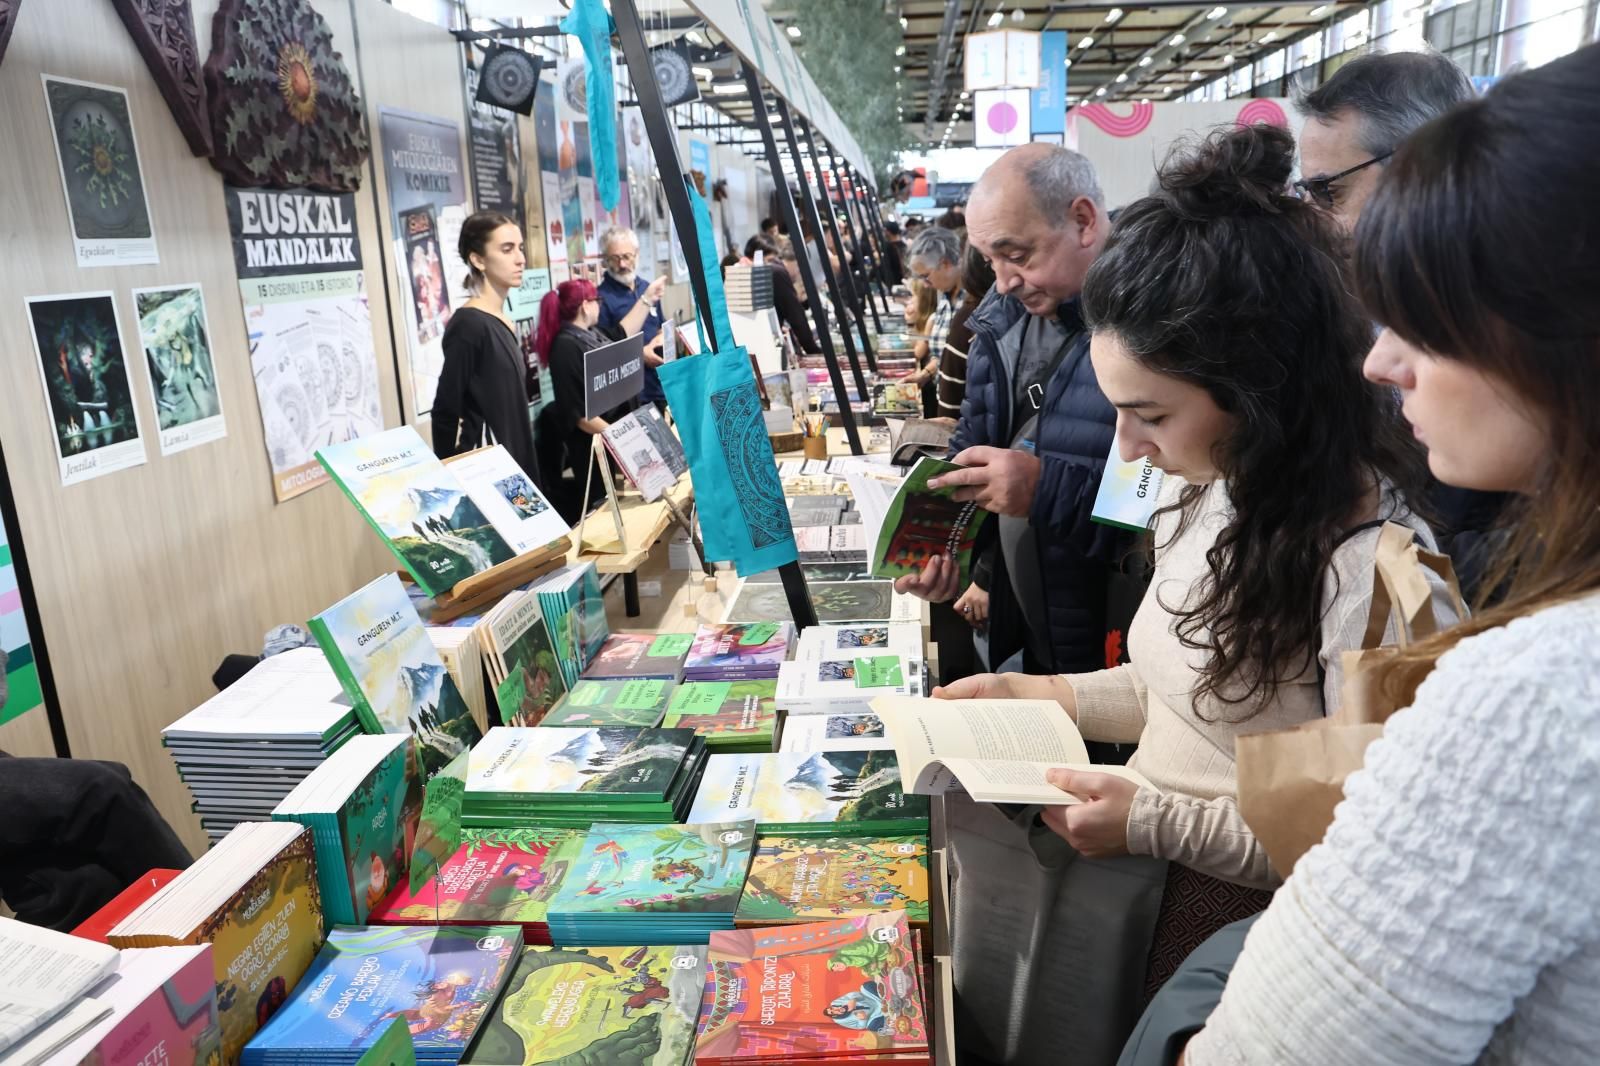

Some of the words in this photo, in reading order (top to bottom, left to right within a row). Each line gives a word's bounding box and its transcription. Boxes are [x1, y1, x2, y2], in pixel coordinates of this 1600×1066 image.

[408, 133, 442, 154] EUSKAL
[237, 192, 352, 234] EUSKAL
[244, 238, 356, 267] MANDALAK
[258, 284, 268, 297] 15
[301, 280, 315, 294] ETA
[316, 280, 324, 292] 15
[608, 368, 620, 384] ETA
[358, 619, 392, 646] GANGUREN
[728, 776, 744, 808] GANGUREN
[225, 944, 256, 980] NEGAR
[251, 919, 278, 952] EGITEN
[273, 898, 298, 926] ZUEN
[238, 951, 267, 982] OGRO
[350, 958, 379, 984] BAREKO
[760, 955, 777, 993] TRIPONTZI
[355, 975, 384, 1001] PERLAK
[778, 971, 796, 1008] ZUHURRA
